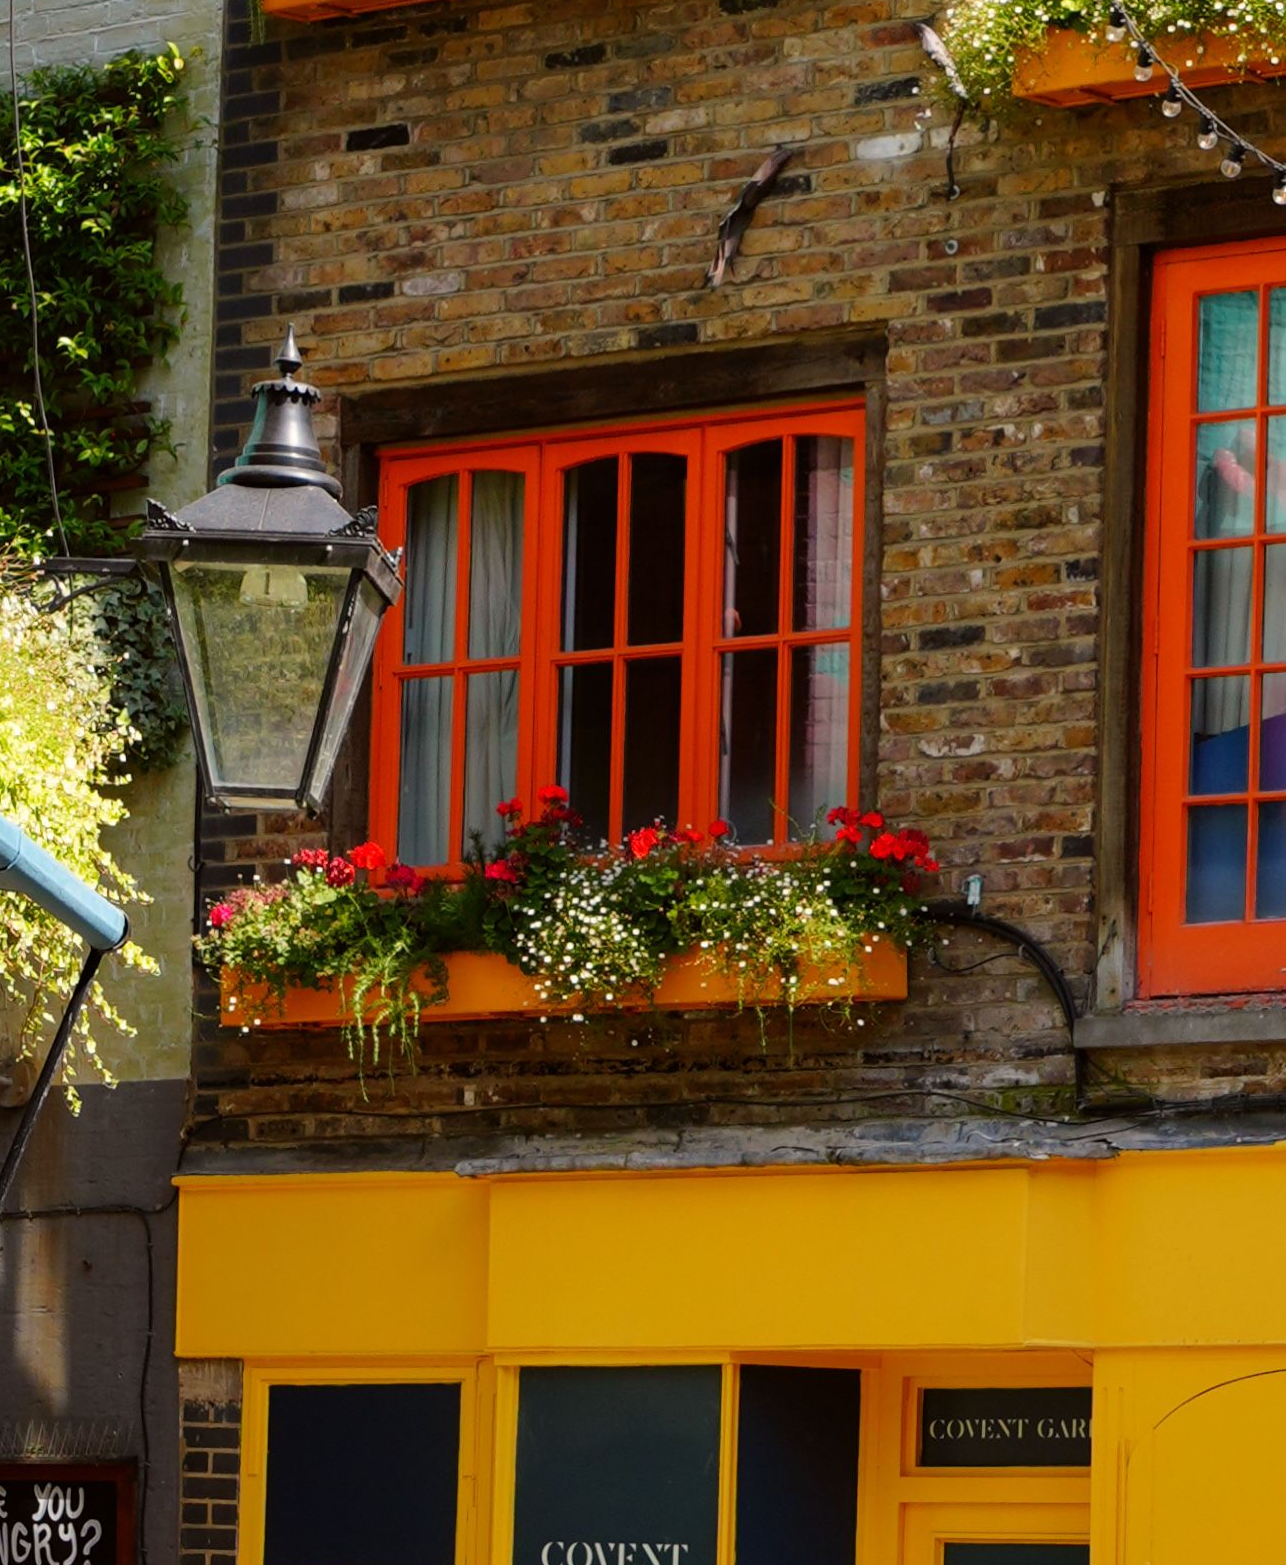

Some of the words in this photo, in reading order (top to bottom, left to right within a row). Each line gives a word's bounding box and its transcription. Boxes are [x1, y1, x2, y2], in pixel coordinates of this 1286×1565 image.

[928, 1418, 1030, 1439] COVENT
[1036, 1418, 1092, 1439] GAR
[31, 1482, 85, 1521] YOU
